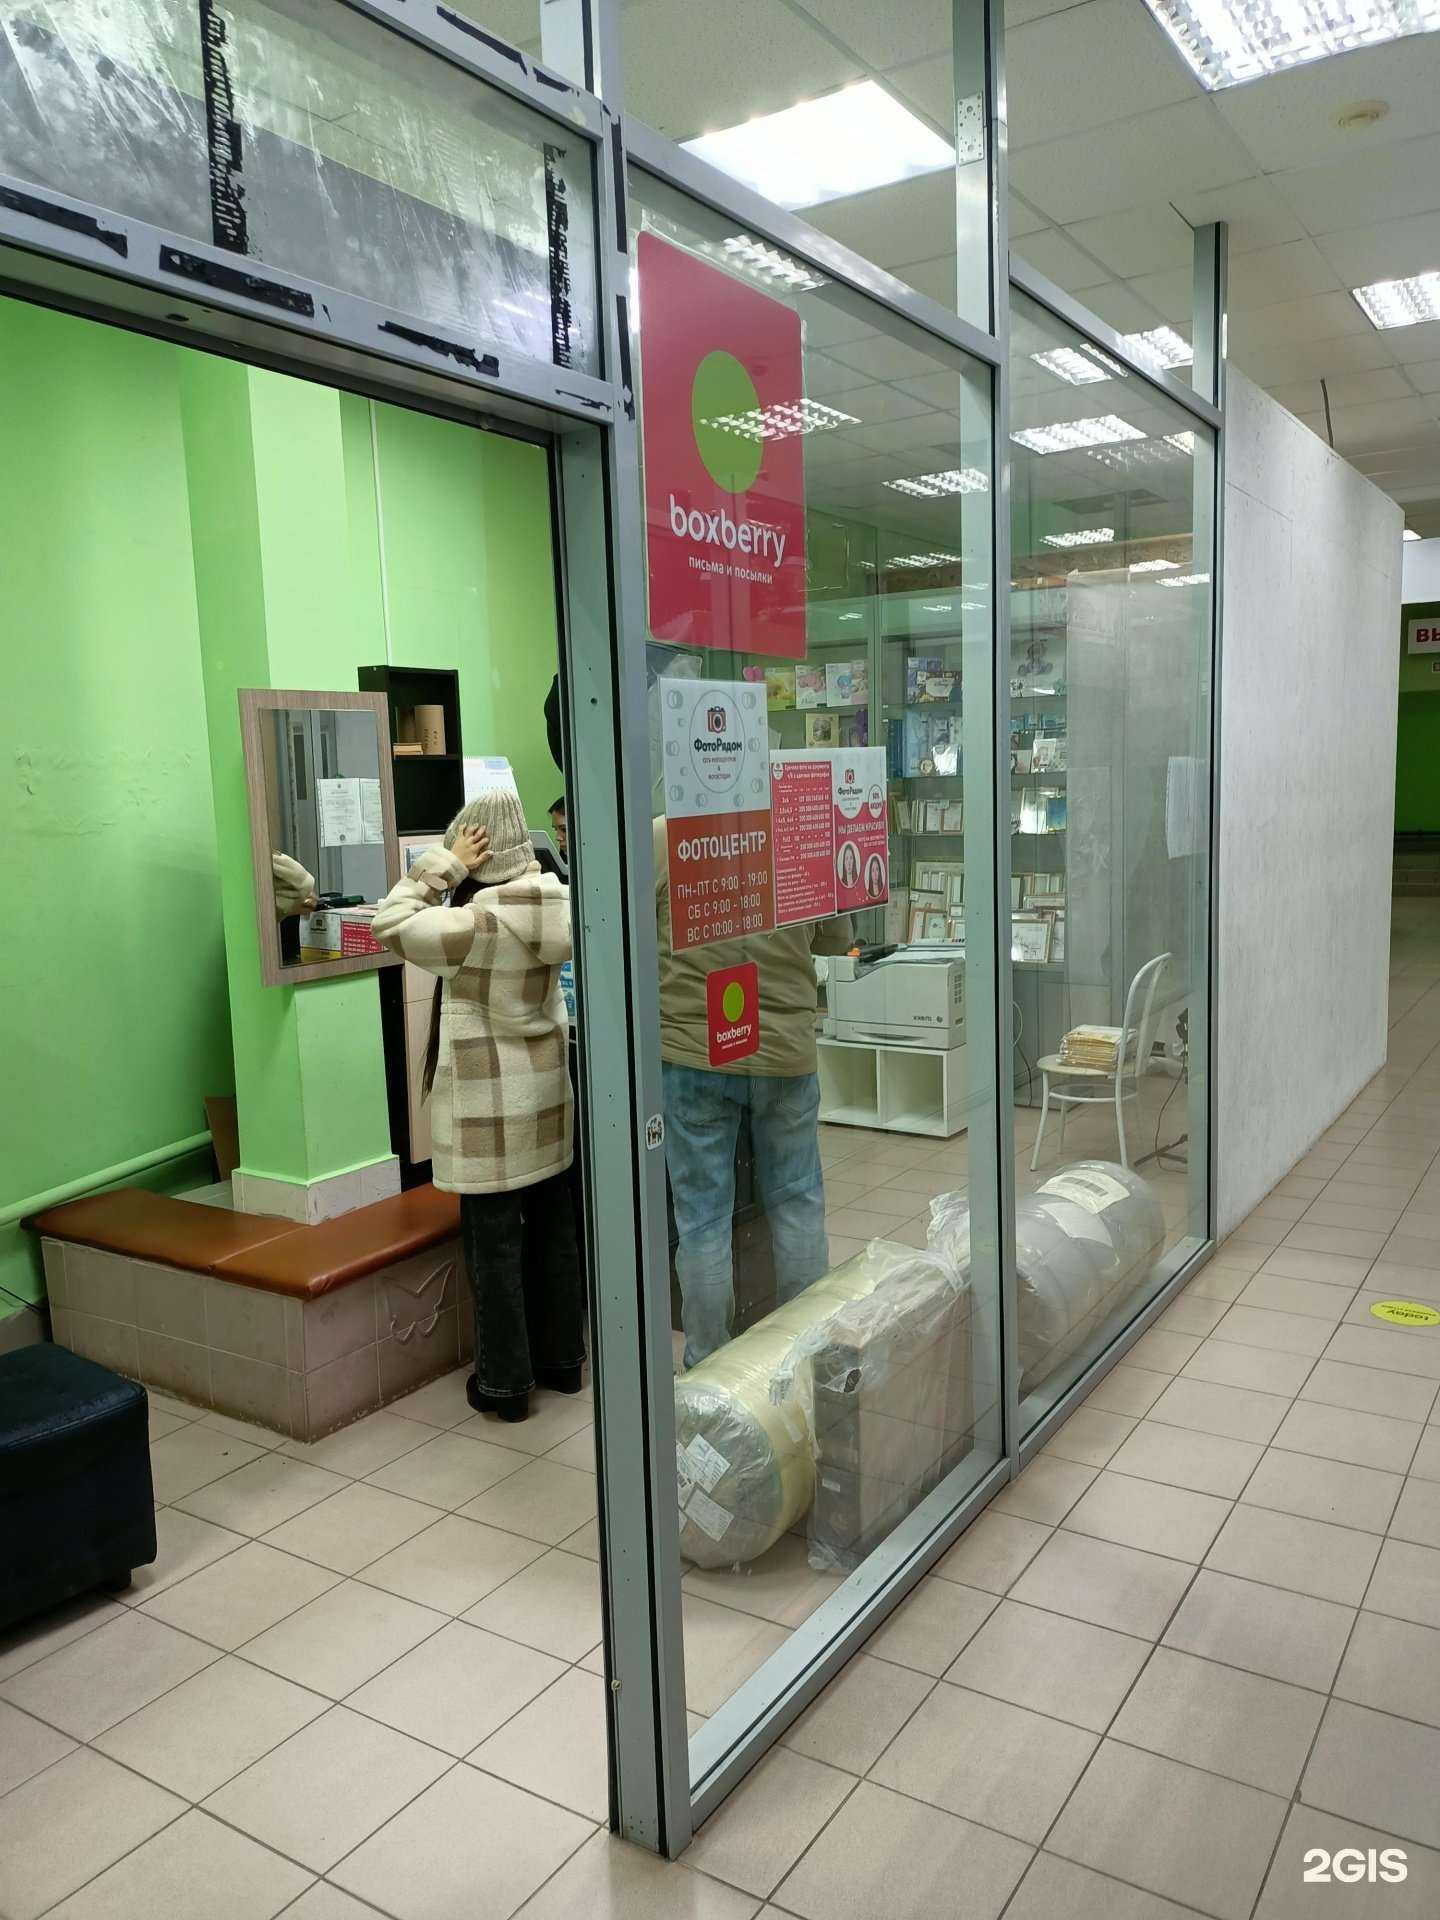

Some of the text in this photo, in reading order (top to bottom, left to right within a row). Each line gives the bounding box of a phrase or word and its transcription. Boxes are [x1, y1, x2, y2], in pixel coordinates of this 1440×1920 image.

[670, 493, 786, 568] boxberry
[688, 556, 773, 585] письма и посылки
[693, 737, 743, 753] ФотоРядом
[677, 830, 767, 862] ФОТОЦЕНТР
[677, 880, 710, 899] ПН-ПТ
[712, 879, 719, 893] С
[721, 875, 739, 891] 9:00
[748, 870, 768, 887] 19:00
[688, 904, 701, 920] СБ
[704, 902, 710, 917] С
[712, 898, 731, 914] 9:00
[740, 892, 761, 909] 18:00
[687, 926, 700, 942] ВС
[703, 924, 710, 939] С
[712, 919, 733, 937] 10:00
[742, 913, 763, 930] 18:00
[716, 1023, 752, 1044] boxberry
